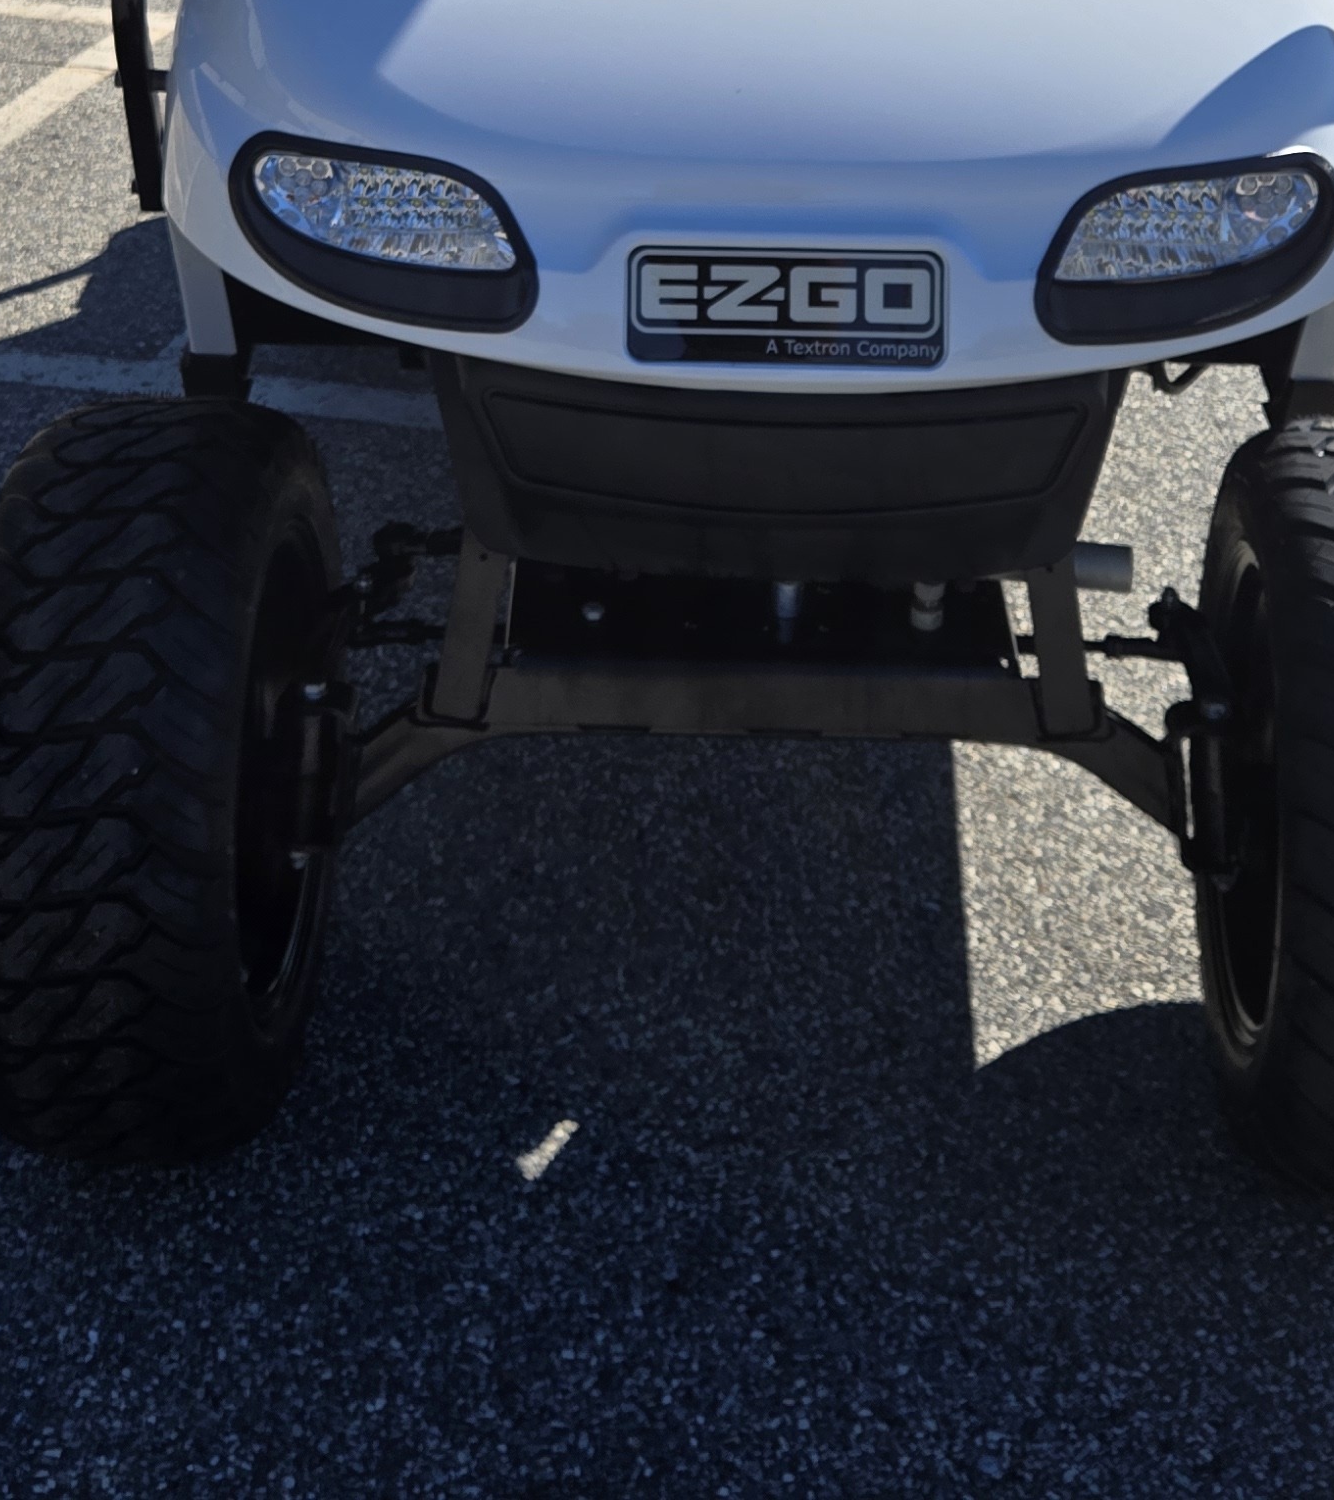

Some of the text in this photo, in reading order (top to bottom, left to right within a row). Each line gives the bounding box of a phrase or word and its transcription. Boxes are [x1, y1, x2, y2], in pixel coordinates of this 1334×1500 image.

[766, 339, 941, 362] A Textron Company
